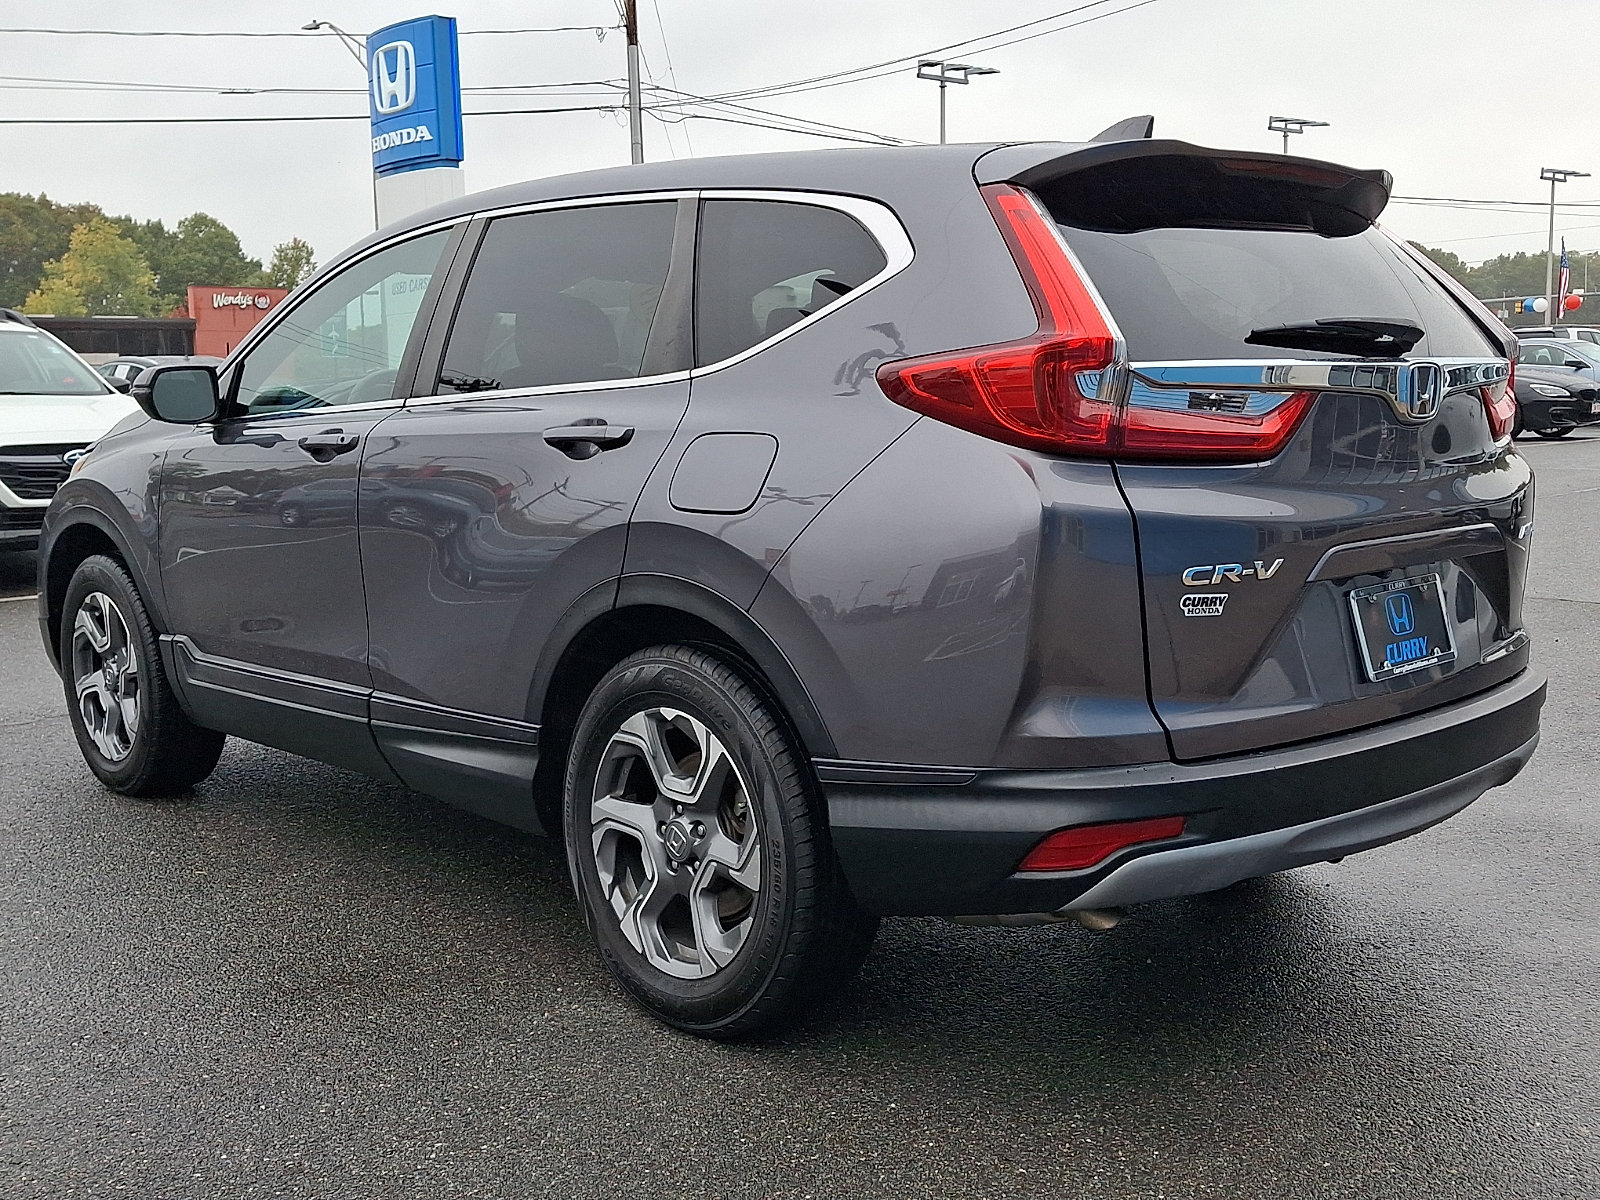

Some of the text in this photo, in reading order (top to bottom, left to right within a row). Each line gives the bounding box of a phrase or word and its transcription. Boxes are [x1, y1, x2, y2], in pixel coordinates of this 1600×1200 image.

[372, 126, 434, 153] HONDA
[391, 277, 429, 296] USED CARS
[213, 291, 253, 309] Wendy's
[1182, 558, 1285, 586] CR-V
[1182, 595, 1227, 608] CURRY
[1186, 607, 1221, 615] HONDA
[1386, 635, 1428, 665] CURRY
